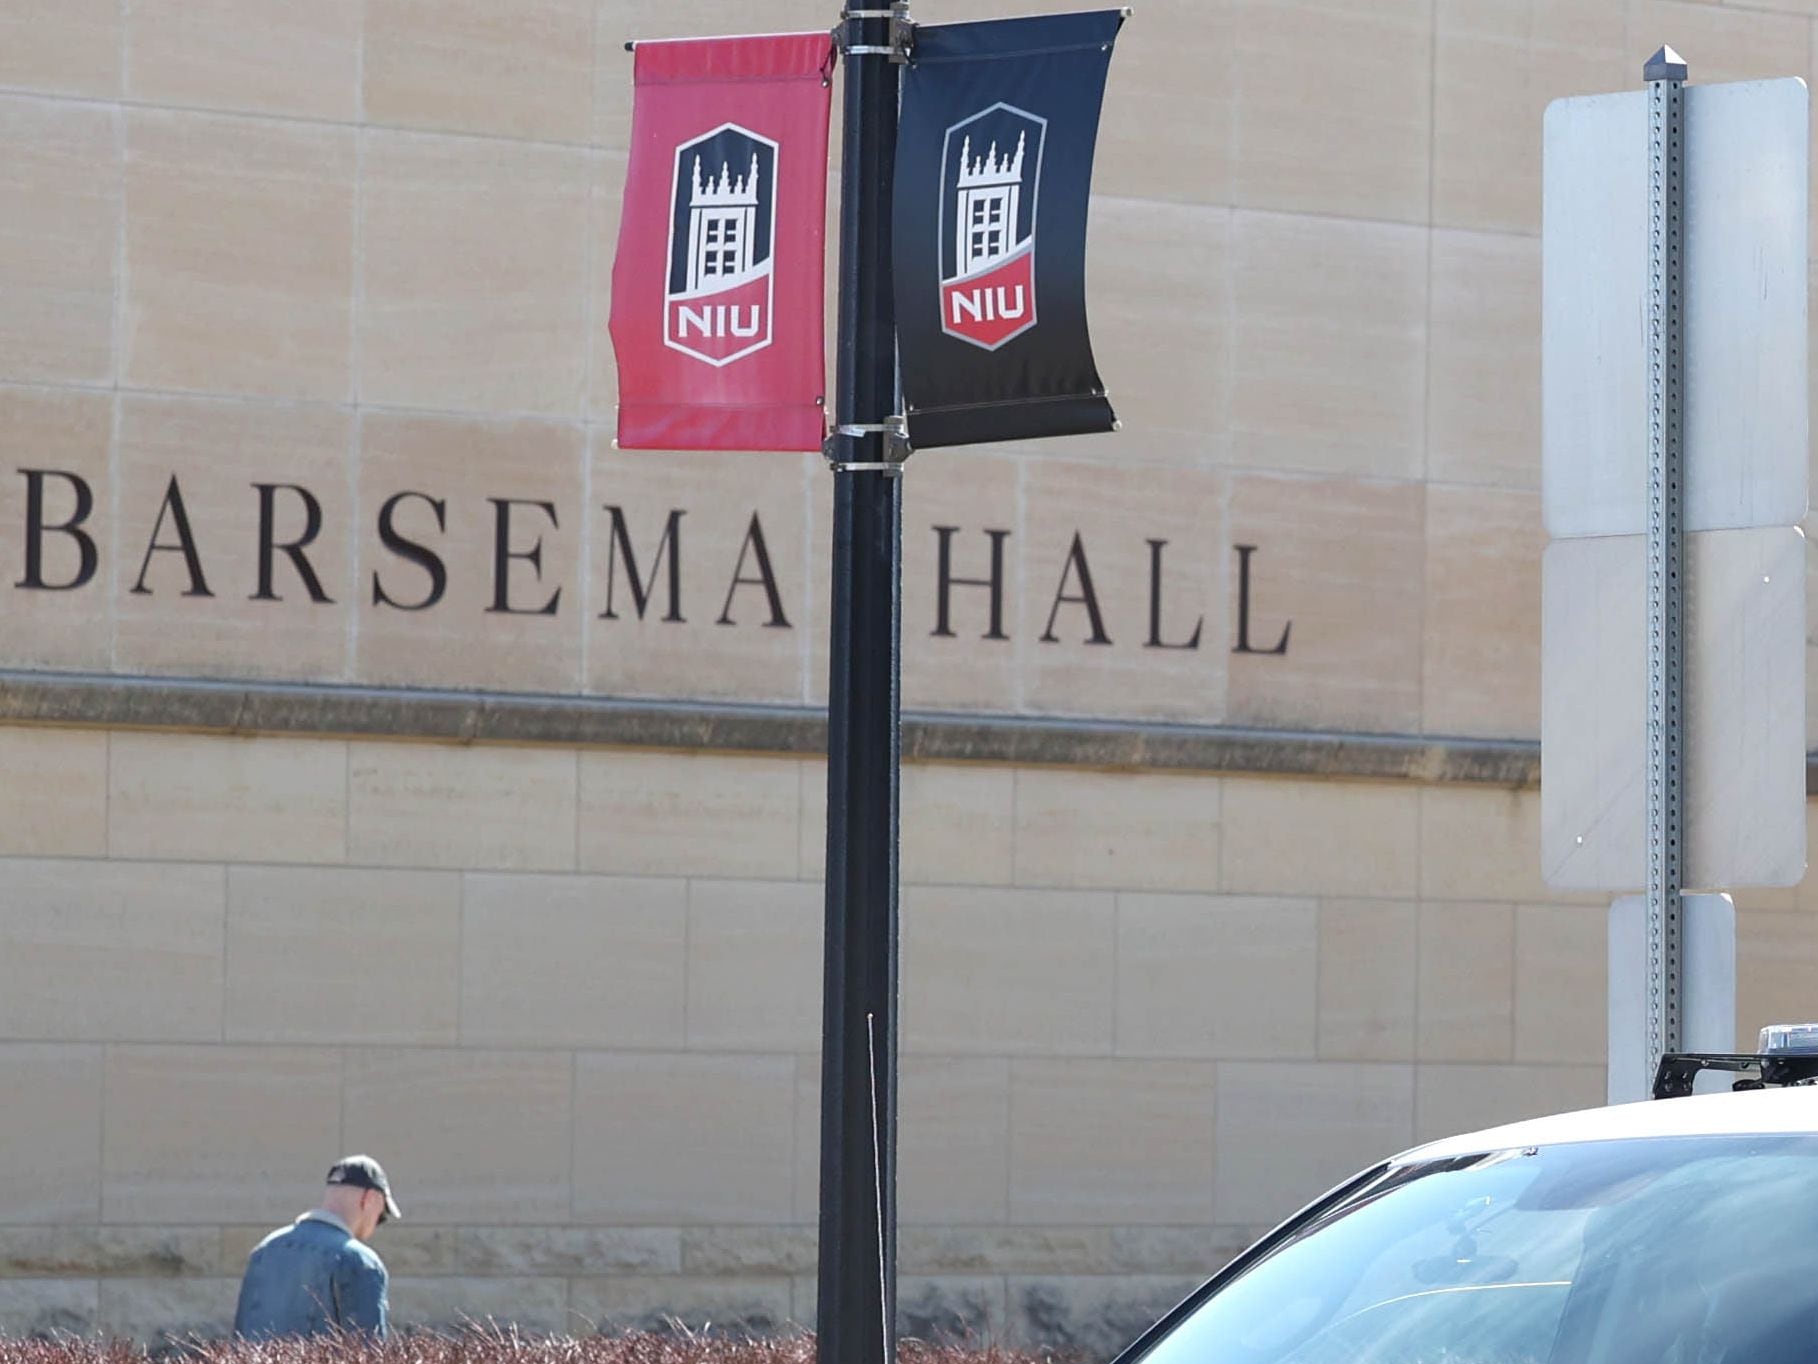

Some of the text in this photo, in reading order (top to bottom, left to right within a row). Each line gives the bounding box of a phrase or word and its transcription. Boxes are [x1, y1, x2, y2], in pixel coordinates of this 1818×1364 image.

[678, 304, 760, 338] NIU
[951, 285, 1025, 325] NIU
[14, 468, 1292, 655] BARSEMA HALL
